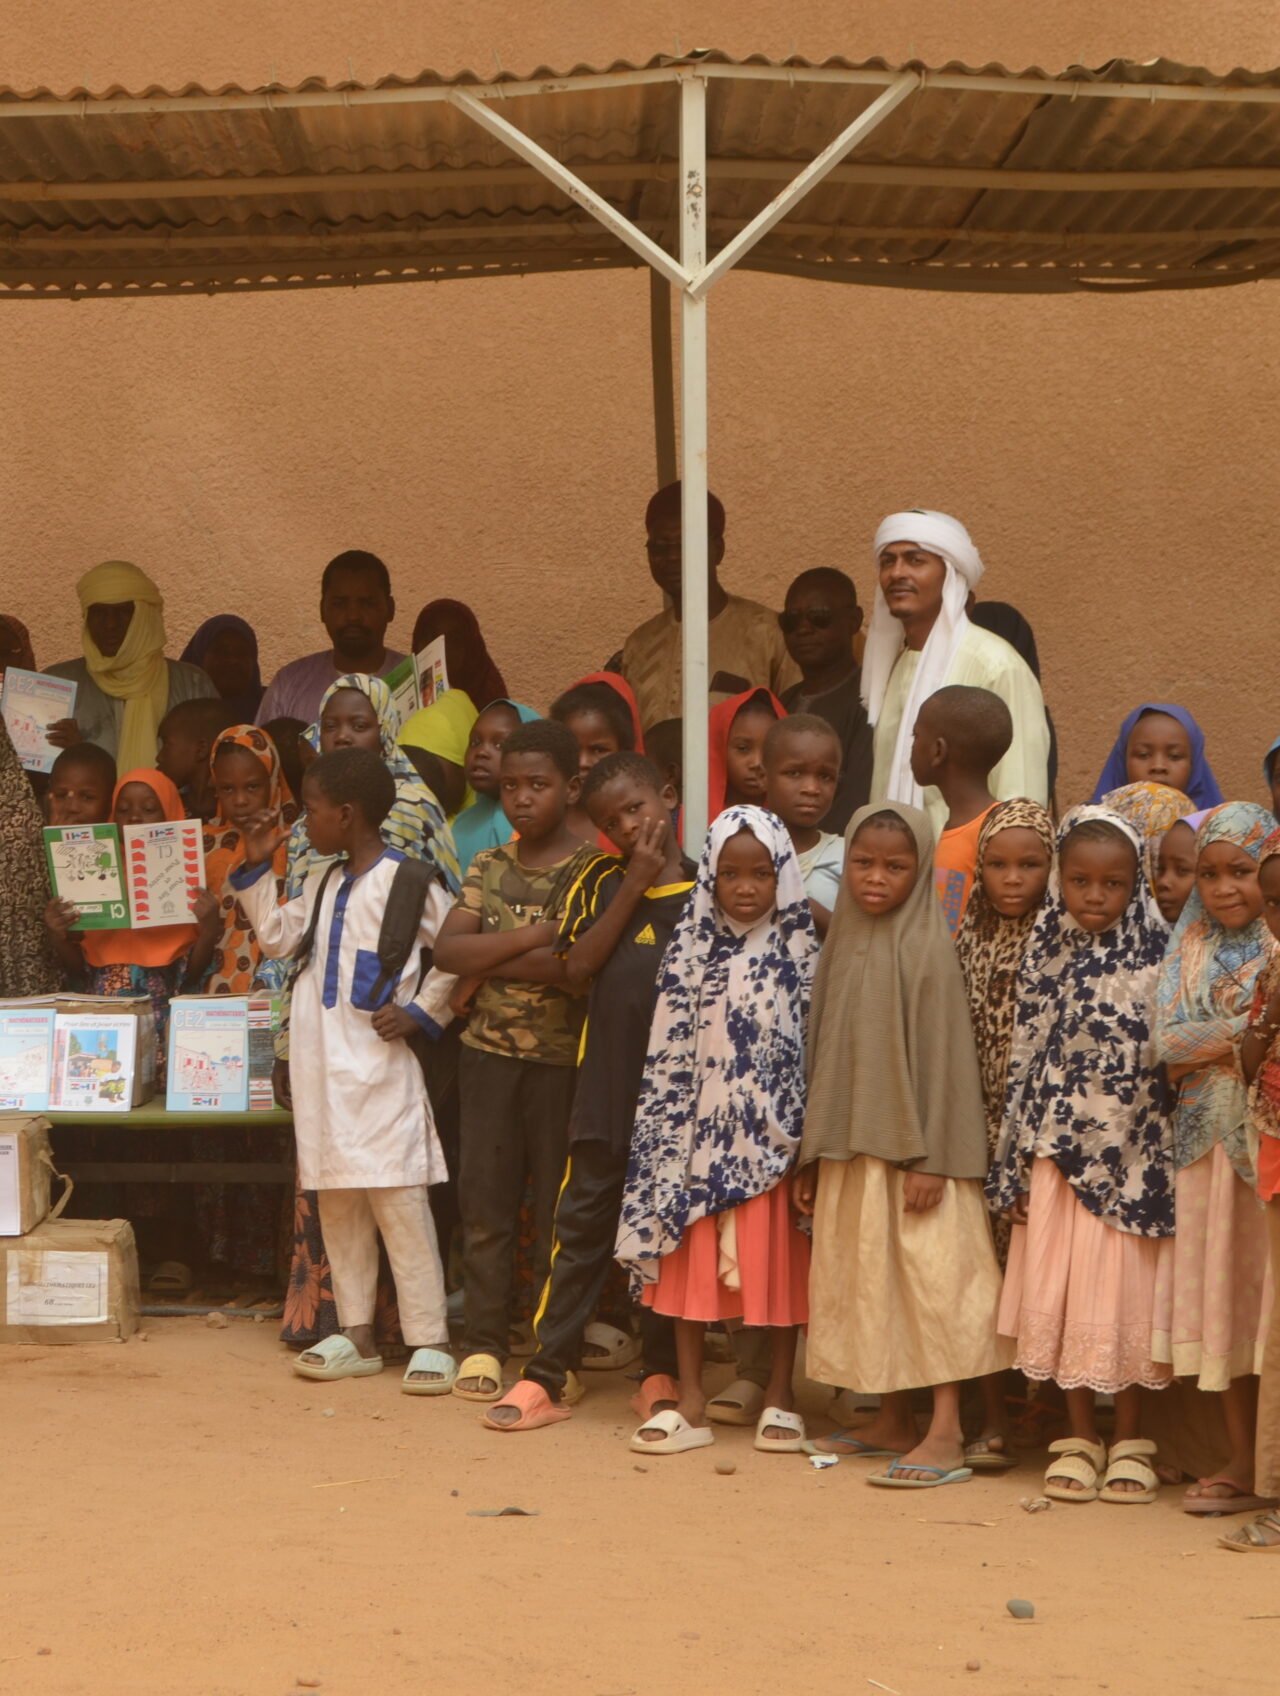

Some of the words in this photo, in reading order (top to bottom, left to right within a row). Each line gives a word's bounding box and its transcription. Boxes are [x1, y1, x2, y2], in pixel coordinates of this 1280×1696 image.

[7, 674, 34, 694] CE2
[110, 903, 126, 919] CI
[173, 1009, 206, 1029] CE2
